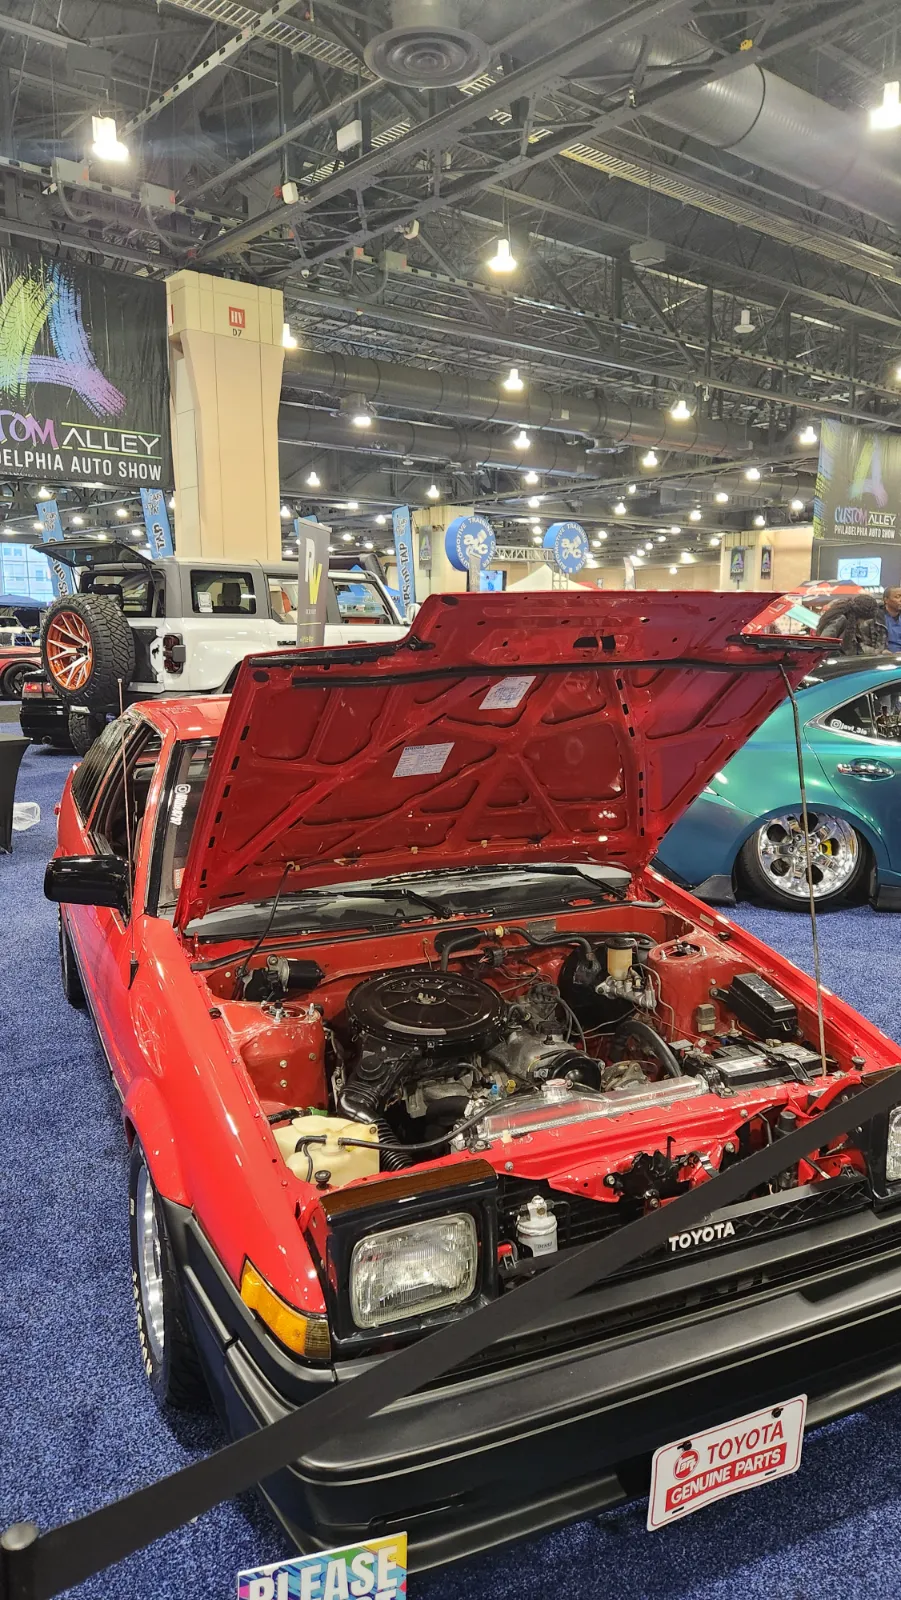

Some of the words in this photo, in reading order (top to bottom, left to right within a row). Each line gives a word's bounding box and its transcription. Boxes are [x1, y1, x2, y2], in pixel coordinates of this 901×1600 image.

[232, 328, 242, 337] D7
[62, 427, 160, 455] ALLEY
[0, 448, 64, 472] ELPHIA
[71, 455, 112, 476] AUTO
[119, 461, 162, 481] SHOW
[468, 517, 494, 537] TRAINING
[835, 506, 868, 526] CUSTOM
[868, 513, 896, 526] ALLEY
[834, 524, 868, 537] PHILADELPHIA
[869, 528, 881, 538] AUTO
[882, 529, 895, 539] SHOW
[399, 542, 410, 564] TAP
[668, 1221, 736, 1252] TOYOTA
[707, 1420, 784, 1465] TOYOTA
[671, 1465, 731, 1504] GENUINE
[734, 1448, 782, 1478] PARTS
[249, 1545, 399, 1600] PLEASE
